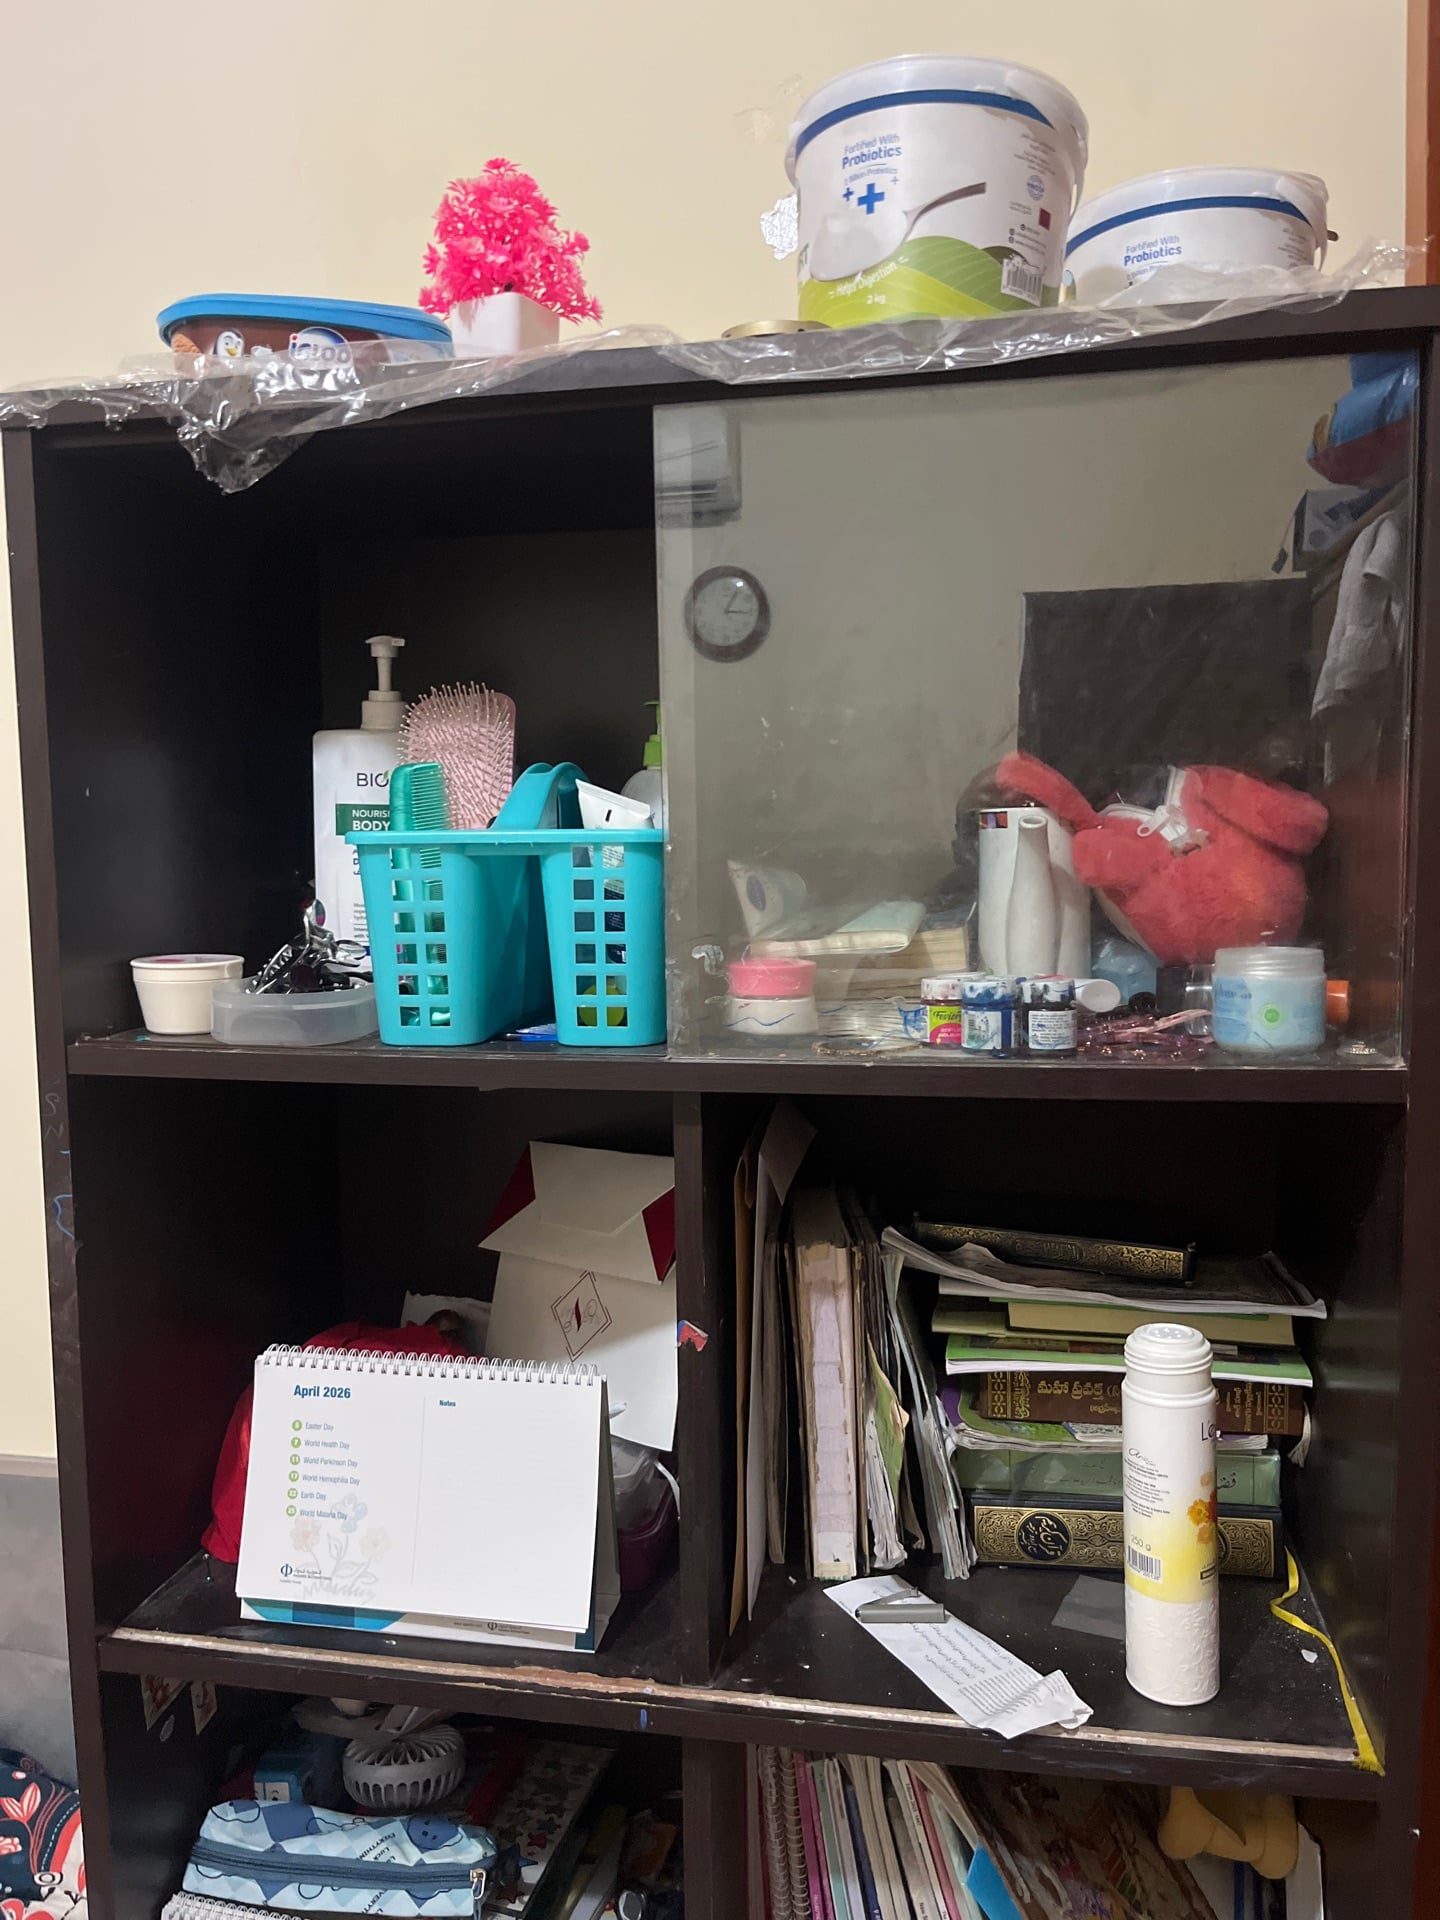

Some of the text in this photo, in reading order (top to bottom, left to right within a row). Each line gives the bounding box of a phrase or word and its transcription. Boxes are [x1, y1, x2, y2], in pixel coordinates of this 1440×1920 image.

[845, 134, 900, 154] Fortified With
[842, 146, 902, 170] Probiotics
[1126, 235, 1180, 254] Fortified With
[1124, 246, 1182, 267] Probiotics
[866, 295, 873, 305] 2
[352, 820, 391, 831] BODY
[293, 1385, 351, 1399] April 2026
[305, 1422, 322, 1430] Easter
[323, 1423, 334, 1432] Day
[304, 1440, 320, 1448] World
[321, 1440, 338, 1448] Health
[340, 1441, 350, 1451] Day
[320, 1458, 346, 1466] Parkinson
[347, 1459, 358, 1468] Day
[302, 1474, 318, 1482] World
[349, 1477, 360, 1486] Day
[300, 1491, 315, 1499] Earth
[316, 1492, 326, 1501] Day
[300, 1509, 315, 1517] World
[317, 1510, 336, 1518] Malaria
[337, 1512, 348, 1521] Day
